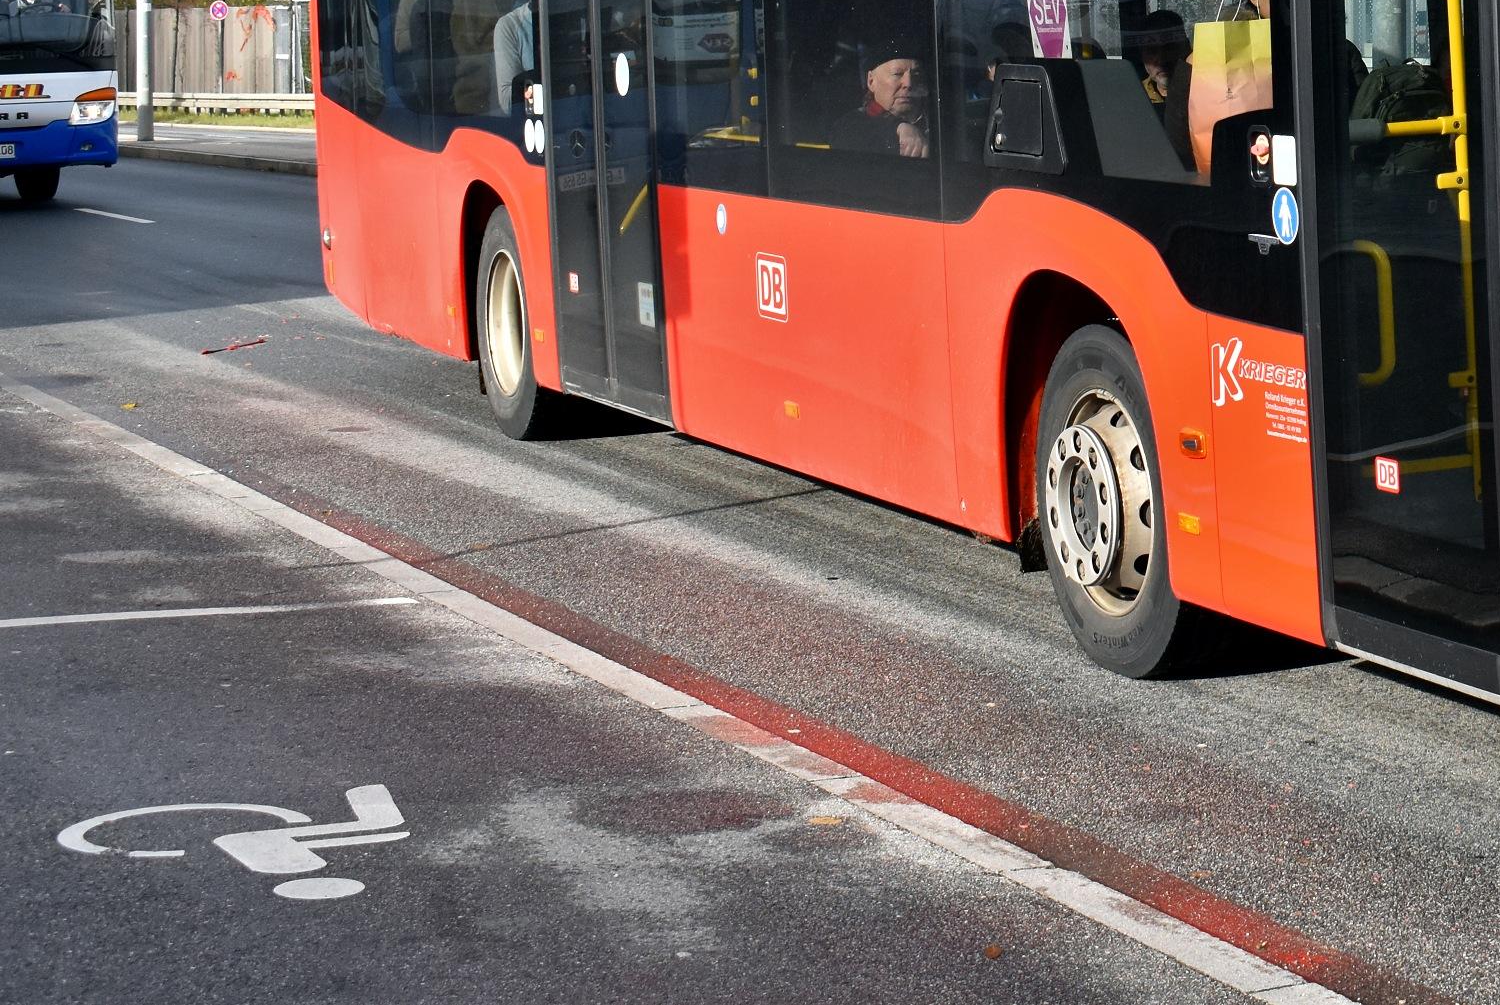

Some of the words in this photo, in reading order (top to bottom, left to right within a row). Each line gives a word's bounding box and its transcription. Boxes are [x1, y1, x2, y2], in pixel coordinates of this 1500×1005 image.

[0, 145, 14, 156] 08
[761, 264, 783, 309] DB
[1211, 337, 1244, 407] K
[1239, 358, 1307, 390] KRIEGER
[1380, 462, 1396, 485] DB
